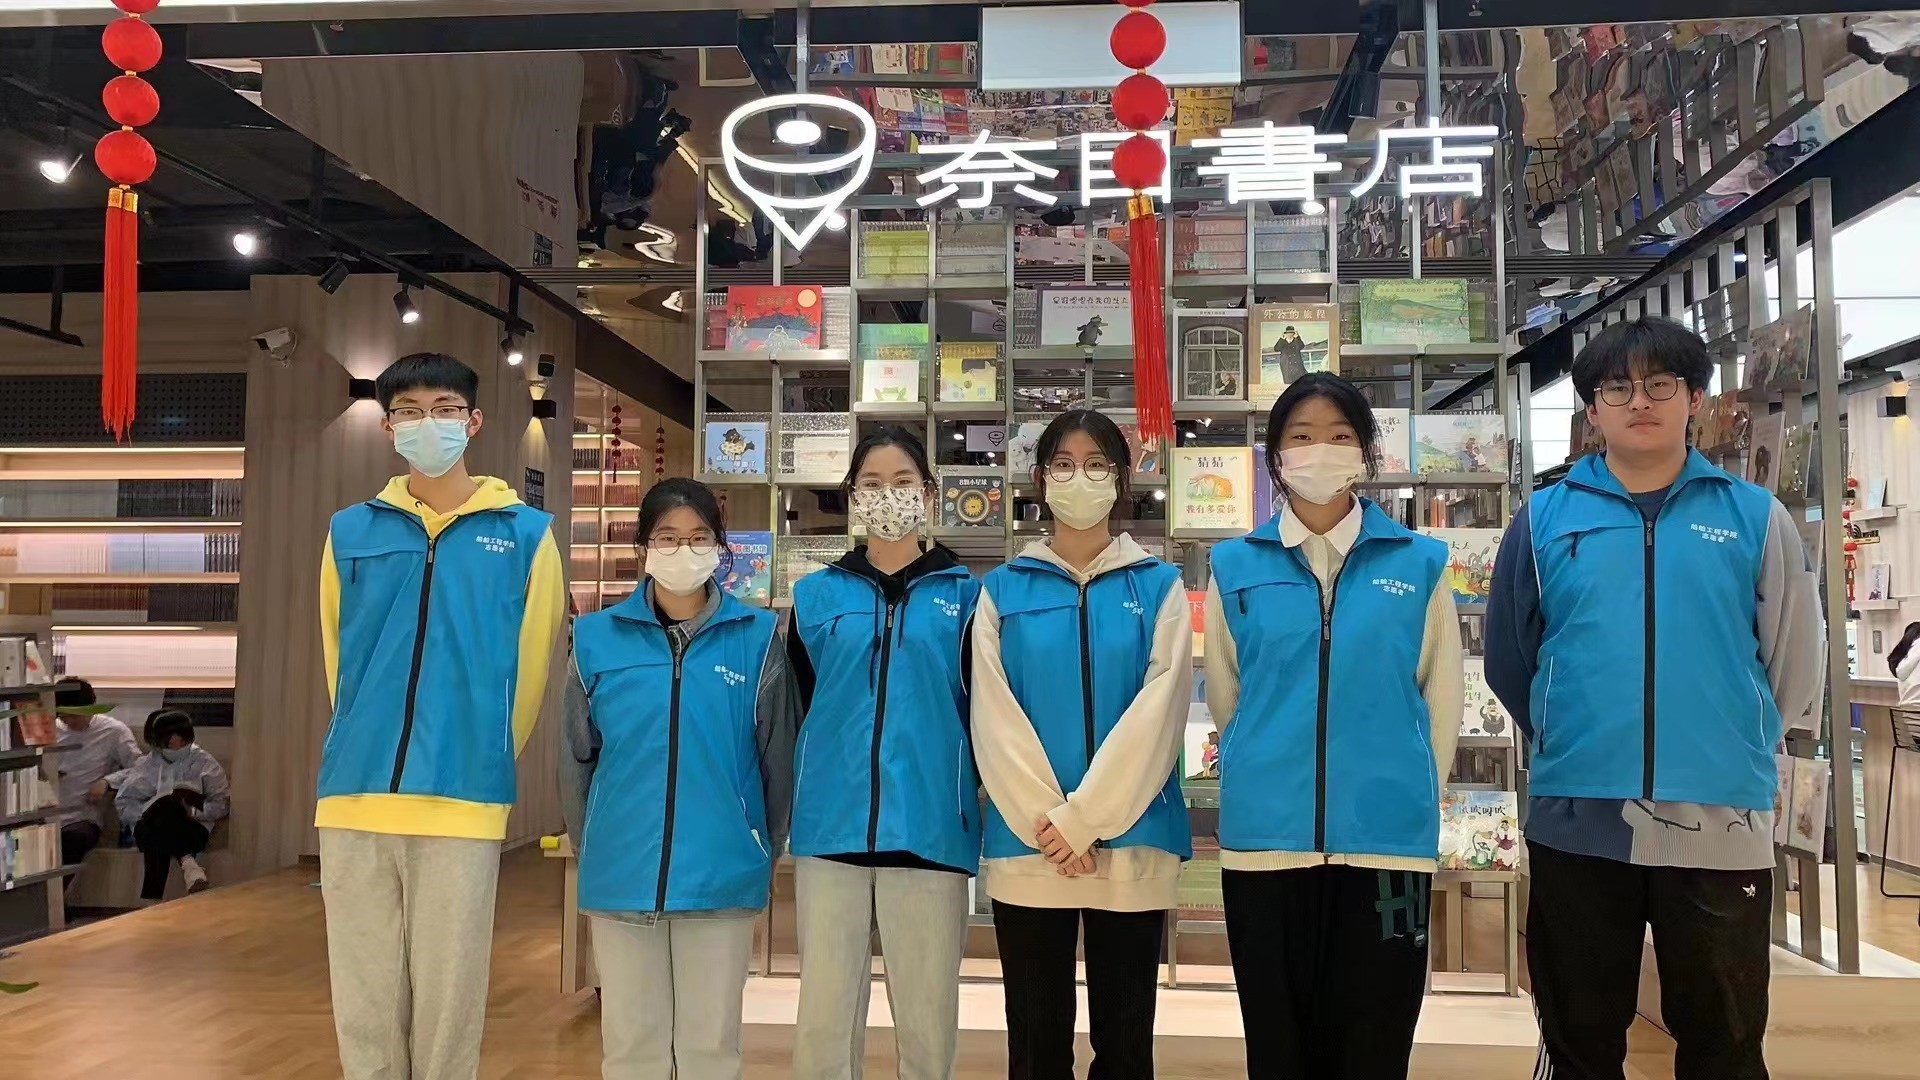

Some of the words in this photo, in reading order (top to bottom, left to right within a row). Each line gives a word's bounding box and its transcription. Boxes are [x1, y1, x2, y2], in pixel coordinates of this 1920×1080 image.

[917, 117, 1499, 206] 奈目書店
[1263, 309, 1326, 319] 外公的旅程
[1198, 457, 1223, 468] 猜猜
[1186, 504, 1236, 514] 我有多爱你
[1690, 523, 1738, 539] 船舶工程学院
[1701, 532, 1725, 543] 志愿者
[1372, 578, 1416, 593] 船舶工程学院
[1383, 585, 1404, 596] 志愿者
